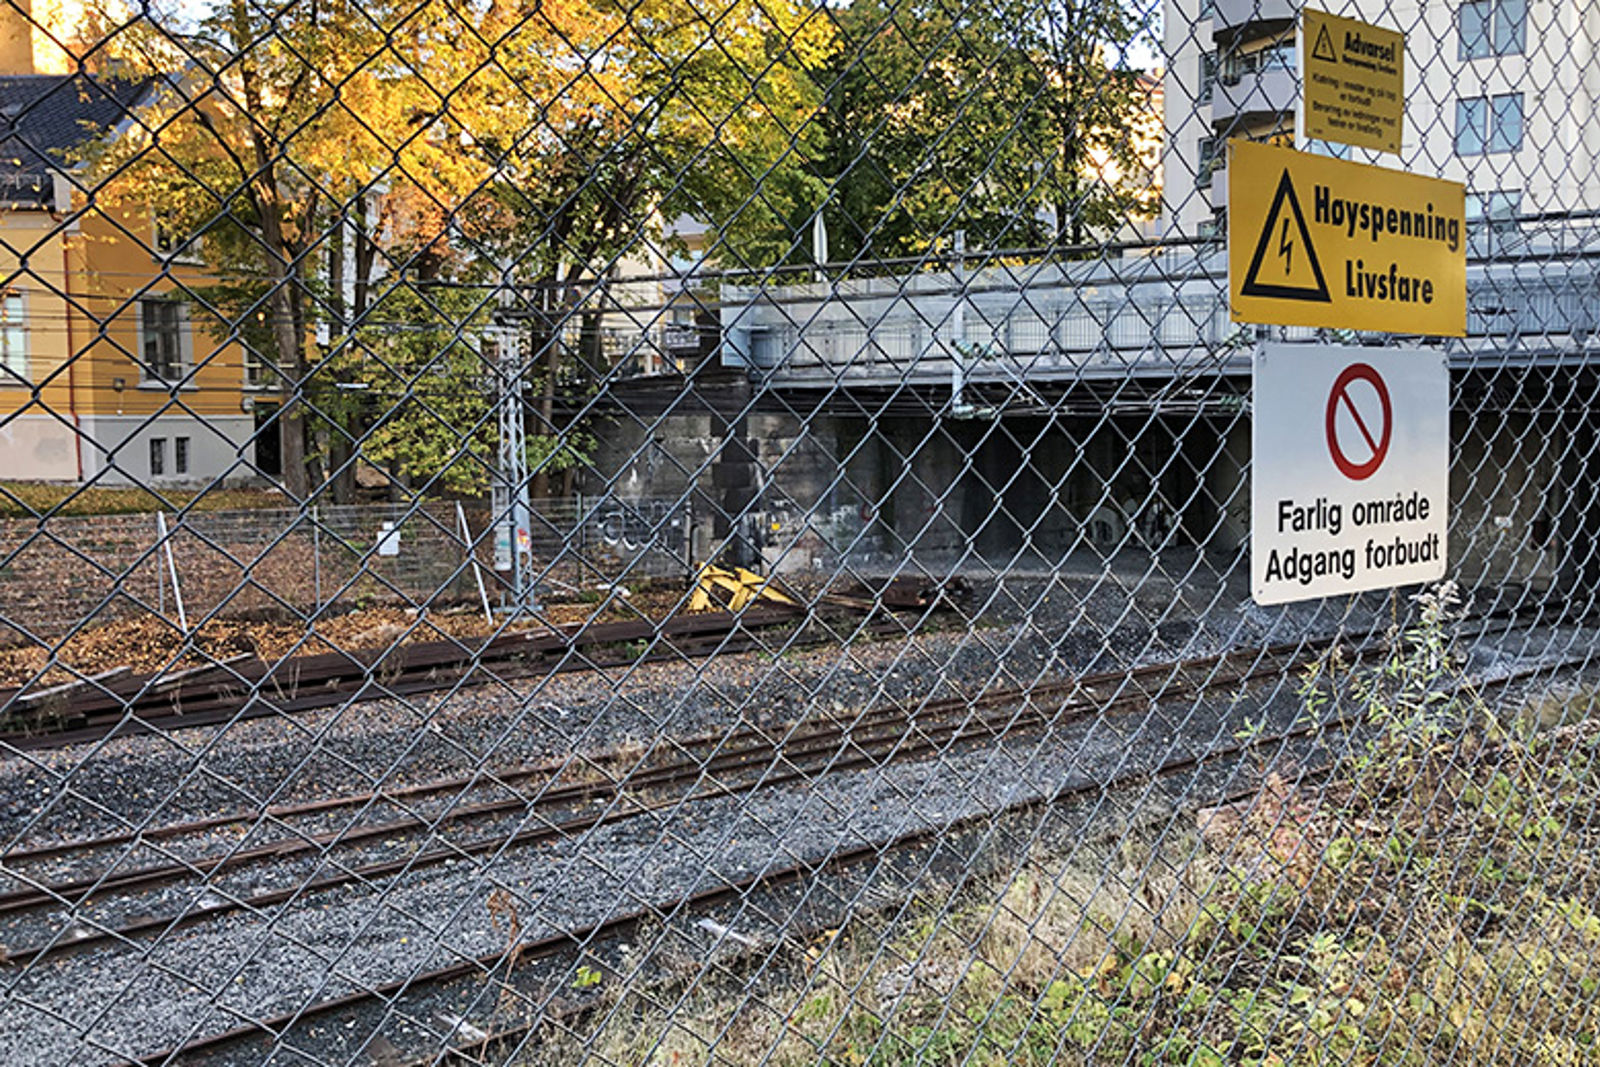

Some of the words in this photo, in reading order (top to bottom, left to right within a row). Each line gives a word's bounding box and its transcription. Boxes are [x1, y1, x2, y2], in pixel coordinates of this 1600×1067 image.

[1345, 32, 1395, 62] Advarsel
[1314, 184, 1459, 253] Høyspenning
[1345, 259, 1434, 305] Livsfare
[1277, 497, 1342, 535] Farlig
[1351, 490, 1430, 527] område
[1264, 547, 1356, 586] Adgang
[1365, 533, 1439, 569] forbudt
